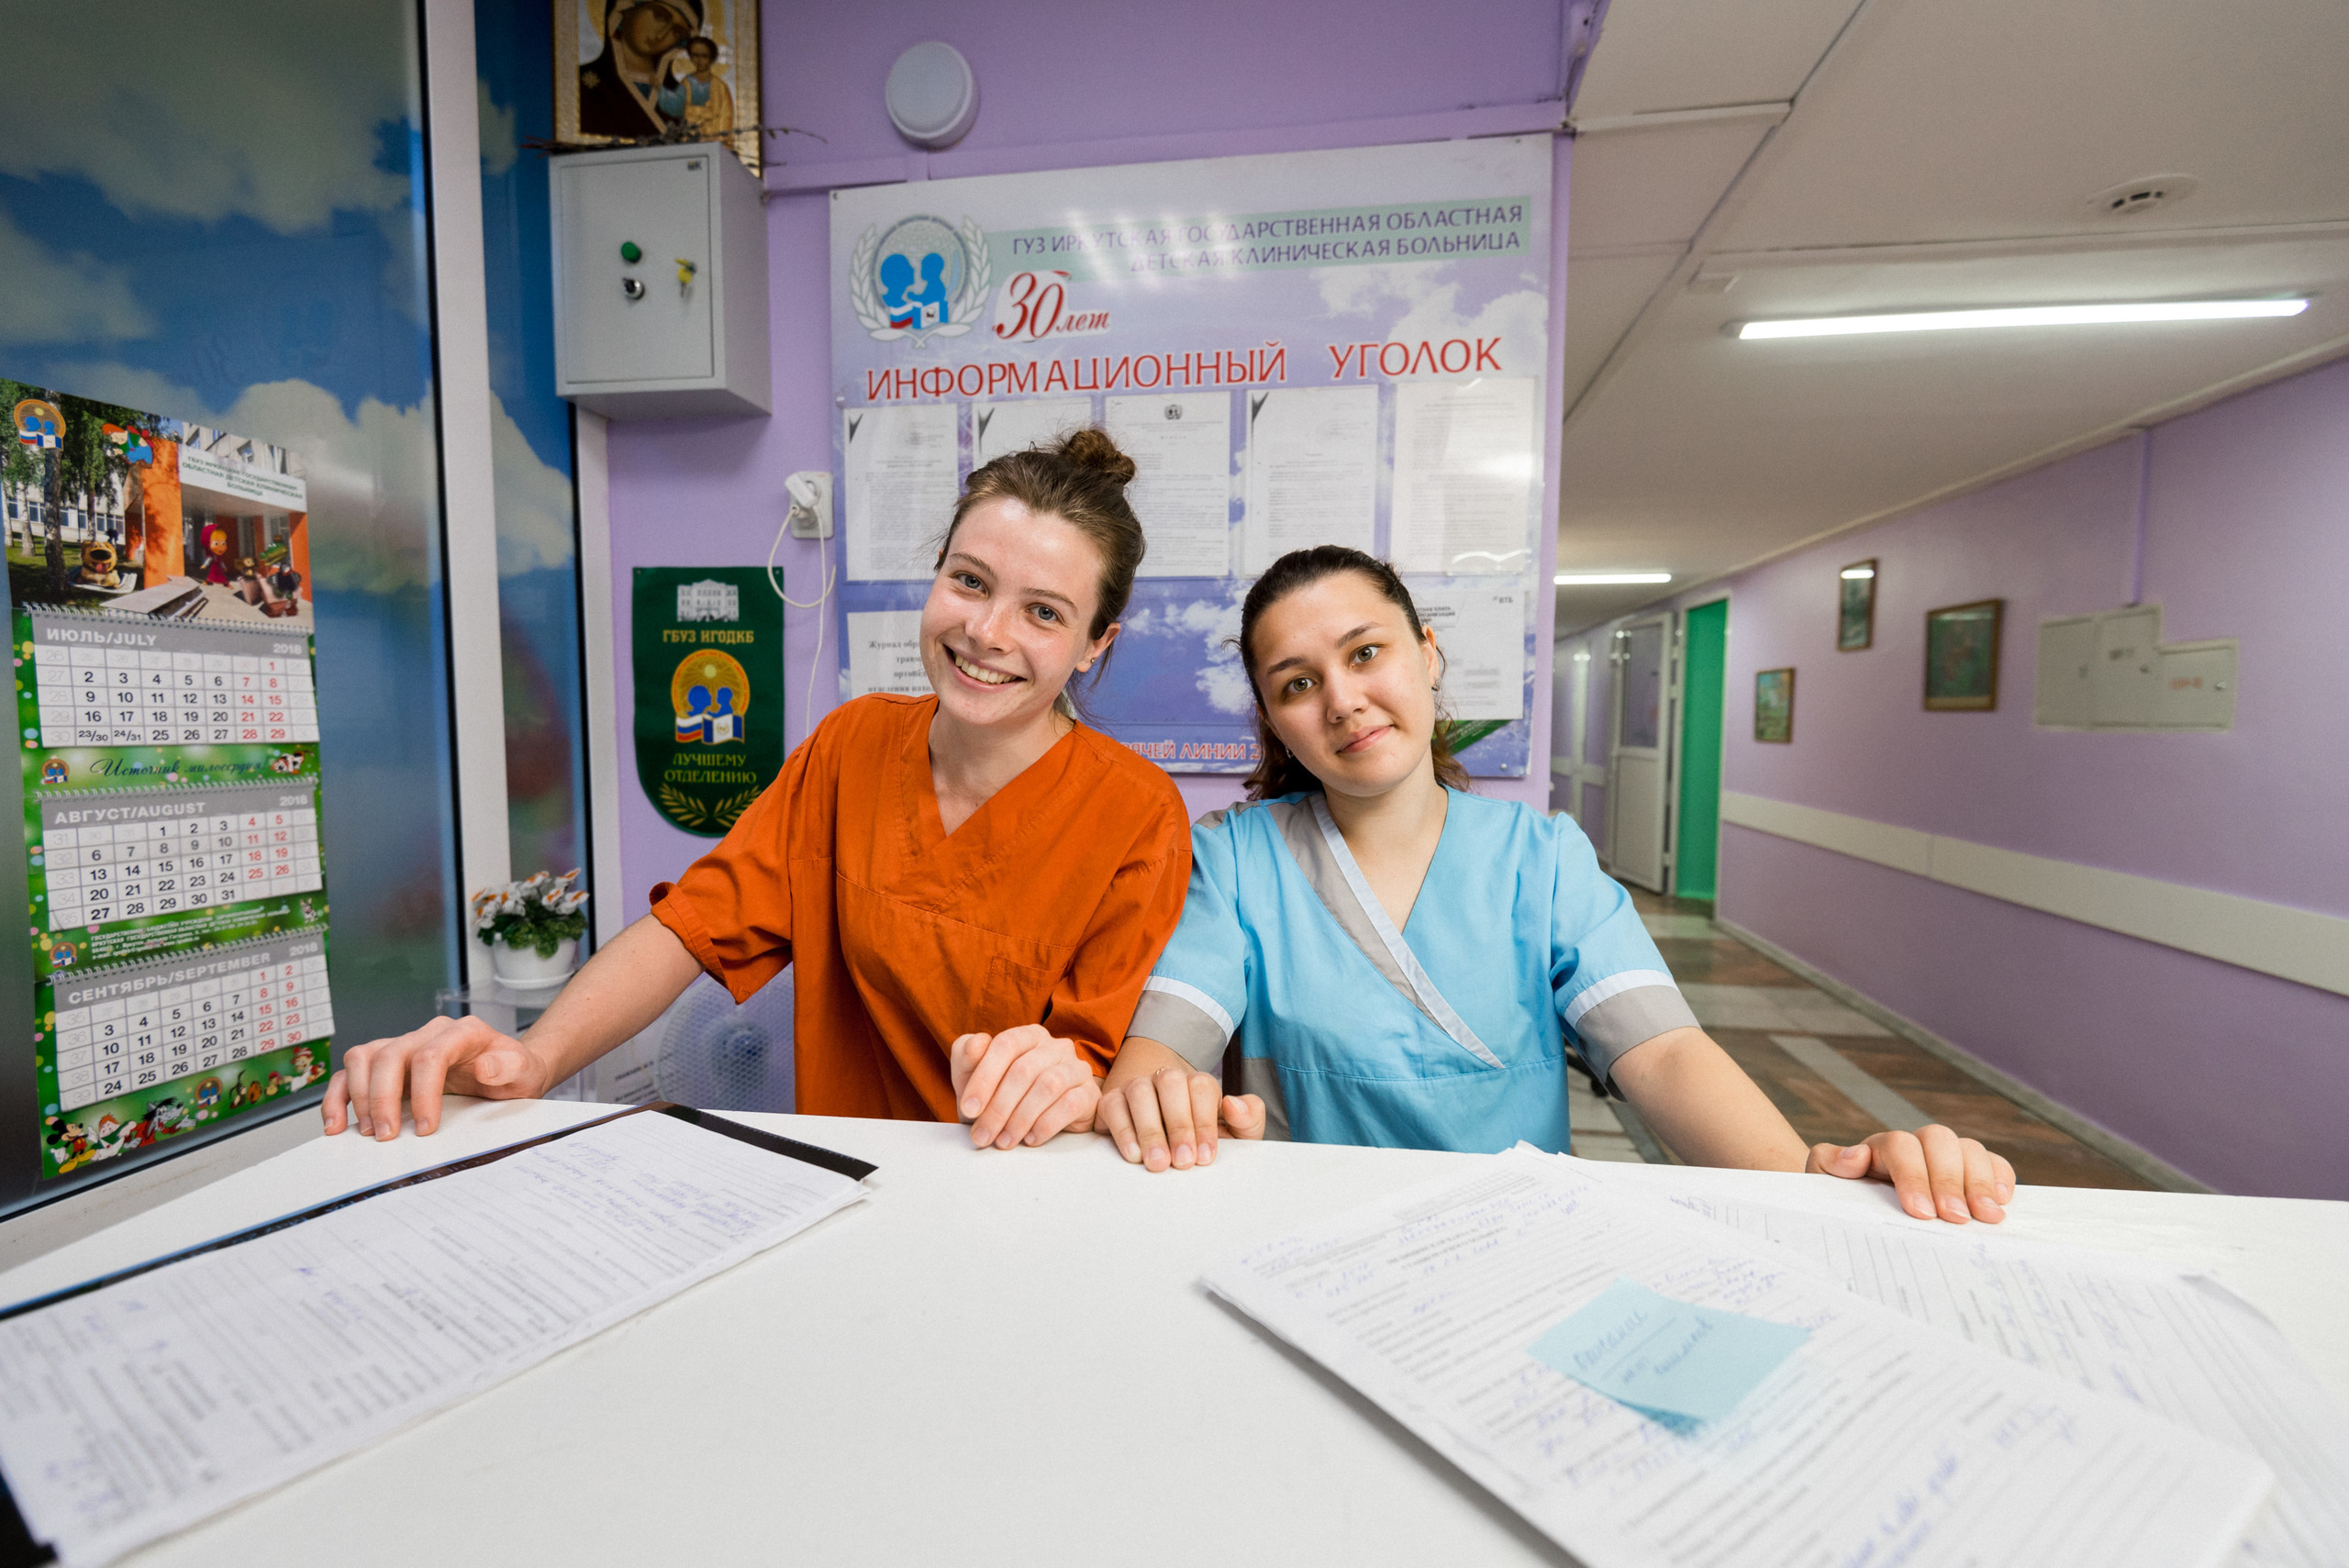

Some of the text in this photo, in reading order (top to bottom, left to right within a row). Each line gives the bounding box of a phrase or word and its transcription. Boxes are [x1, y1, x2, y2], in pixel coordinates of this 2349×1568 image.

[1013, 237, 1045, 255] ГУЗ
[1386, 206, 1522, 230] ОБЛАСТНАЯ
[1231, 239, 1390, 265] КЛИНИЧЕСКАЯ
[1397, 231, 1520, 256] БОЛЬНИЦА
[993, 271, 1109, 339] 30 лет
[867, 337, 1502, 401] ИНФОРМАЦИОННЫЙ УГОЛОК
[47, 628, 302, 654] ИЮЛЬ/JULY 2018
[662, 629, 754, 645] ГБУЗ ИГОДКБ
[84, 671, 94, 683] 2
[119, 673, 128, 684] 3
[152, 674, 161, 684] 4
[184, 674, 193, 685] 5
[214, 676, 222, 686] 6
[242, 677, 250, 687] 7
[270, 678, 277, 688] 8
[270, 662, 274, 671] 1
[85, 691, 95, 703] 9
[117, 692, 133, 703] 10
[151, 693, 164, 703] 11
[183, 693, 197, 704] 12
[213, 694, 227, 705] 13
[241, 695, 254, 705] 14
[268, 695, 282, 706] 15
[84, 711, 102, 722] 16
[119, 711, 134, 722] 17
[152, 711, 168, 722] 18
[184, 711, 198, 722] 19
[213, 711, 228, 722] 20
[241, 712, 254, 722] 21
[269, 712, 284, 722] 22
[78, 730, 108, 742] 23/30
[114, 729, 141, 741] 24/31
[152, 729, 169, 740] 25
[184, 729, 200, 740] 26
[214, 729, 228, 740] 27
[242, 728, 258, 740] 28
[271, 728, 285, 739] 29
[673, 752, 747, 768] ЛУЧШЕМУ
[1180, 743, 1246, 760] ЛИНИИ
[664, 770, 757, 784] ОТДЕЛЕНИЮ
[55, 795, 307, 824] АВГУСТ/AUGUST 2018
[160, 826, 165, 837] 1
[190, 823, 198, 834] 2
[220, 820, 228, 831] 3
[249, 817, 256, 826] 4
[275, 815, 284, 825] 5
[92, 850, 102, 862] 6
[127, 846, 135, 857] 7
[160, 843, 169, 854] 8
[191, 840, 199, 851] 9
[218, 836, 232, 847] 10
[247, 834, 259, 844] 11
[274, 831, 286, 841] 12
[90, 869, 106, 881] 13
[125, 865, 140, 876] 14
[159, 861, 173, 873] 15
[190, 857, 204, 868] 16
[219, 853, 233, 864] 17
[249, 851, 262, 861] 18
[275, 847, 288, 858] 19
[90, 888, 109, 901] 20
[125, 884, 140, 896] 21
[159, 879, 175, 892] 22
[190, 875, 206, 887] 23
[220, 872, 235, 883] 24
[249, 868, 263, 880] 25
[275, 864, 289, 875] 26
[91, 907, 110, 920] 27
[127, 902, 145, 915] 28
[160, 897, 176, 910] 29
[191, 893, 207, 905] 30
[221, 889, 235, 900] 31
[69, 942, 318, 1005] СЕНТЯБРЬ/SEPTEMBER 2018
[260, 972, 265, 981] 1
[285, 965, 293, 976] 2
[105, 1024, 114, 1036] 3
[139, 1017, 148, 1027] 4
[173, 1008, 181, 1019] 5
[203, 1001, 211, 1012] 6
[233, 995, 239, 1005] 7
[260, 987, 268, 998] 8
[286, 982, 294, 992] 9
[103, 1042, 119, 1055] 10
[138, 1034, 150, 1047] 11
[171, 1026, 185, 1038] 12
[202, 1018, 216, 1030] 13
[231, 1011, 244, 1022] 14
[259, 1004, 272, 1016] 15
[285, 996, 298, 1008] 16
[105, 1061, 119, 1074] 17
[139, 1052, 155, 1065] 18
[172, 1044, 187, 1056] 19
[202, 1035, 217, 1049] 20
[231, 1029, 244, 1040] 21
[259, 1020, 273, 1033] 22
[285, 1013, 300, 1026] 23
[105, 1080, 122, 1095] 24
[139, 1071, 156, 1084] 25
[172, 1062, 188, 1075] 26
[203, 1054, 217, 1068] 27
[232, 1046, 248, 1060] 28
[261, 1039, 274, 1051] 29
[288, 1031, 301, 1042] 30
